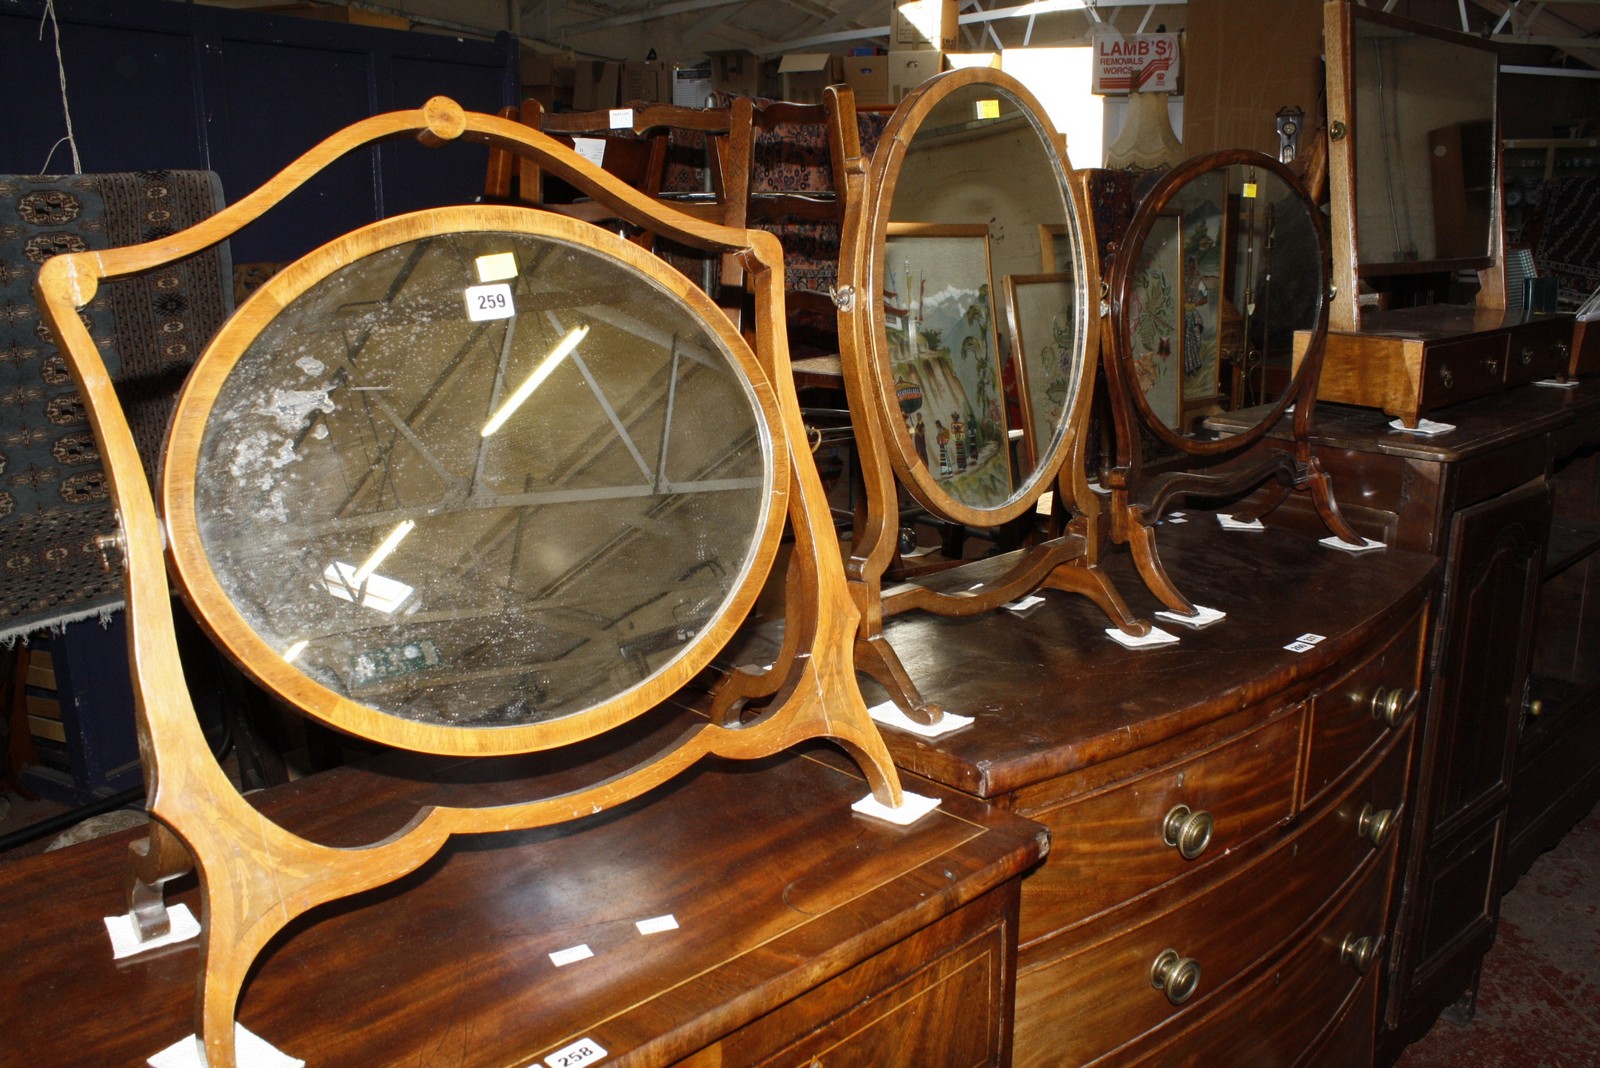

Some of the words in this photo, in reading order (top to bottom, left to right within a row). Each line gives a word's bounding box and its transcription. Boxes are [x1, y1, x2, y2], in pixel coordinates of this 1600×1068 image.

[1100, 40, 1167, 56] LAMB'S
[478, 293, 506, 310] 259
[558, 1046, 594, 1068] 258
